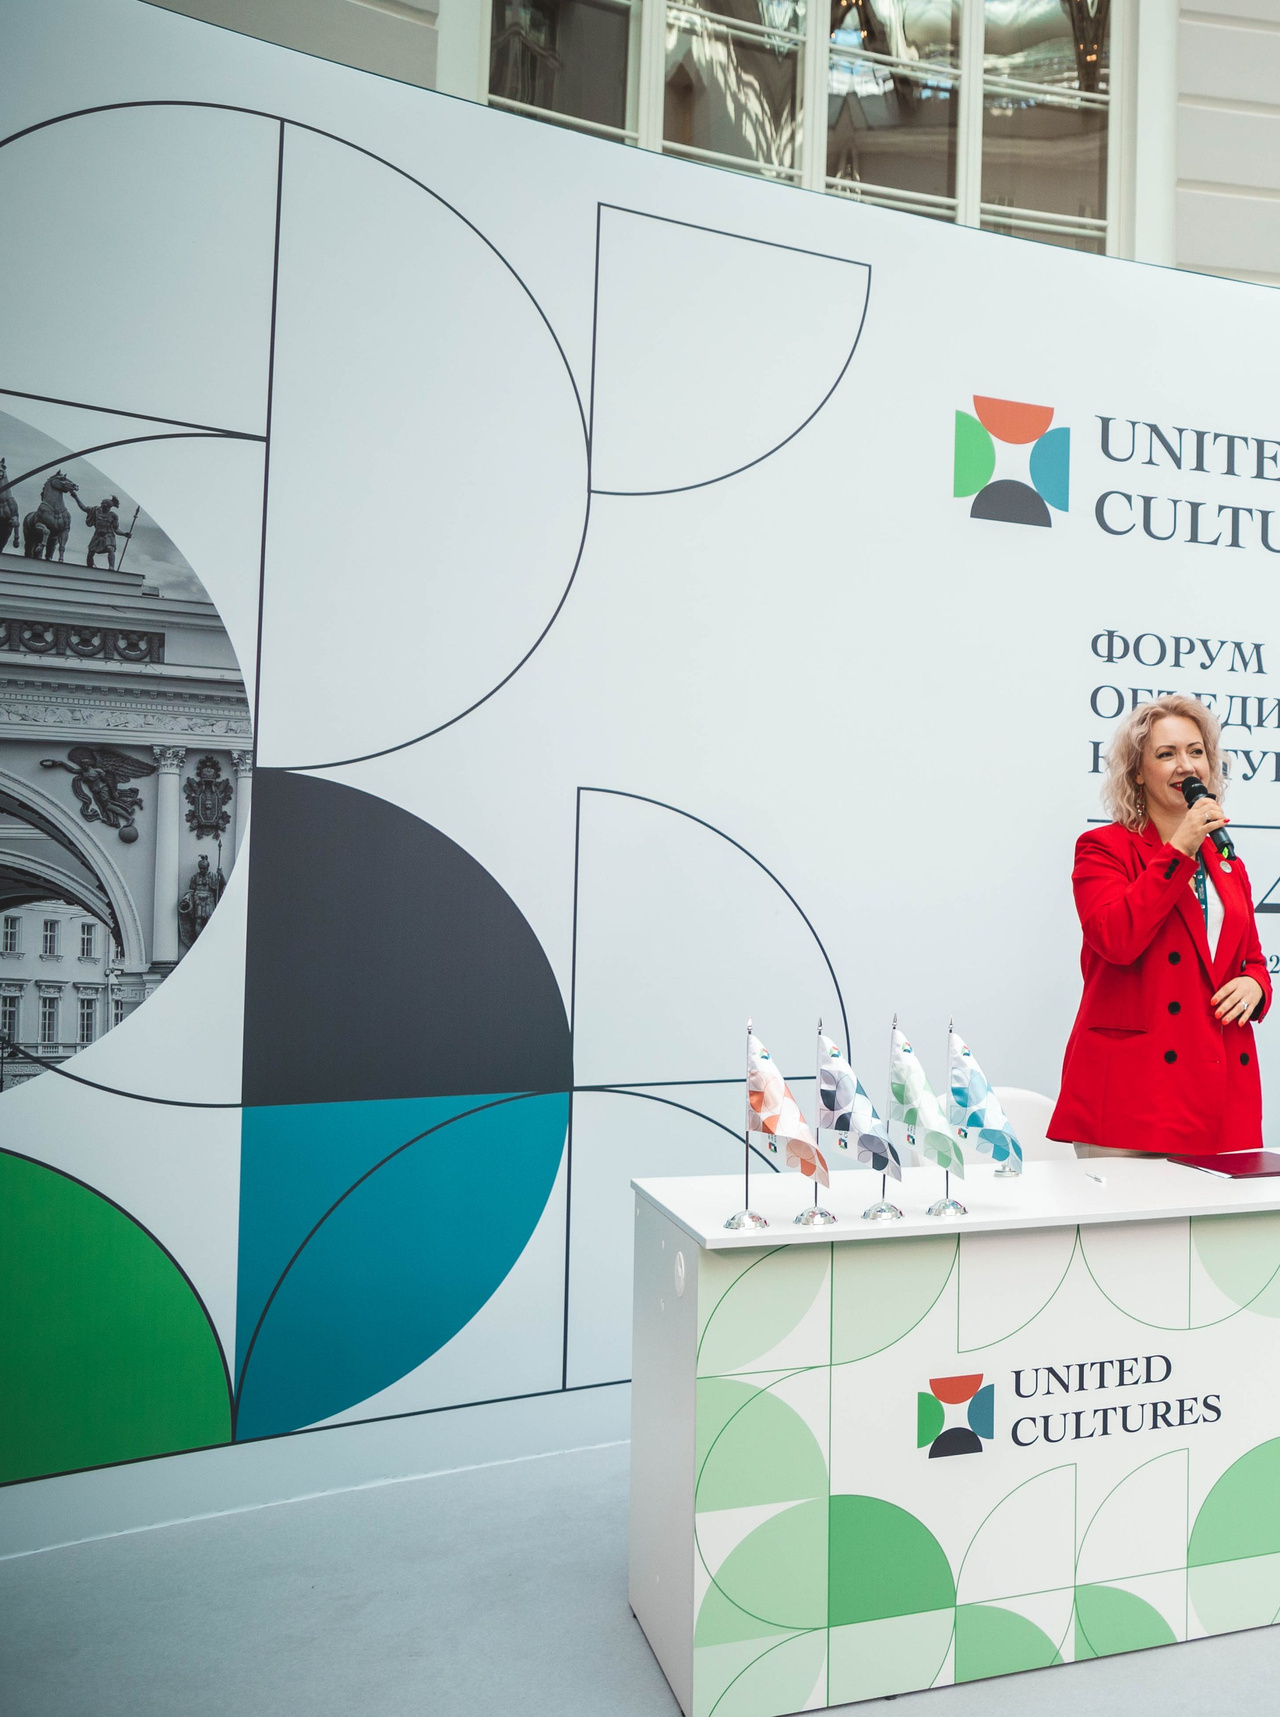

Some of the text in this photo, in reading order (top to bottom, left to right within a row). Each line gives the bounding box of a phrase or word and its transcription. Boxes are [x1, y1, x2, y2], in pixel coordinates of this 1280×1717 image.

[1090, 629, 1267, 675] ФОРУМ
[1010, 1354, 1173, 1400] UNITED
[1010, 1394, 1222, 1448] CULTURES
